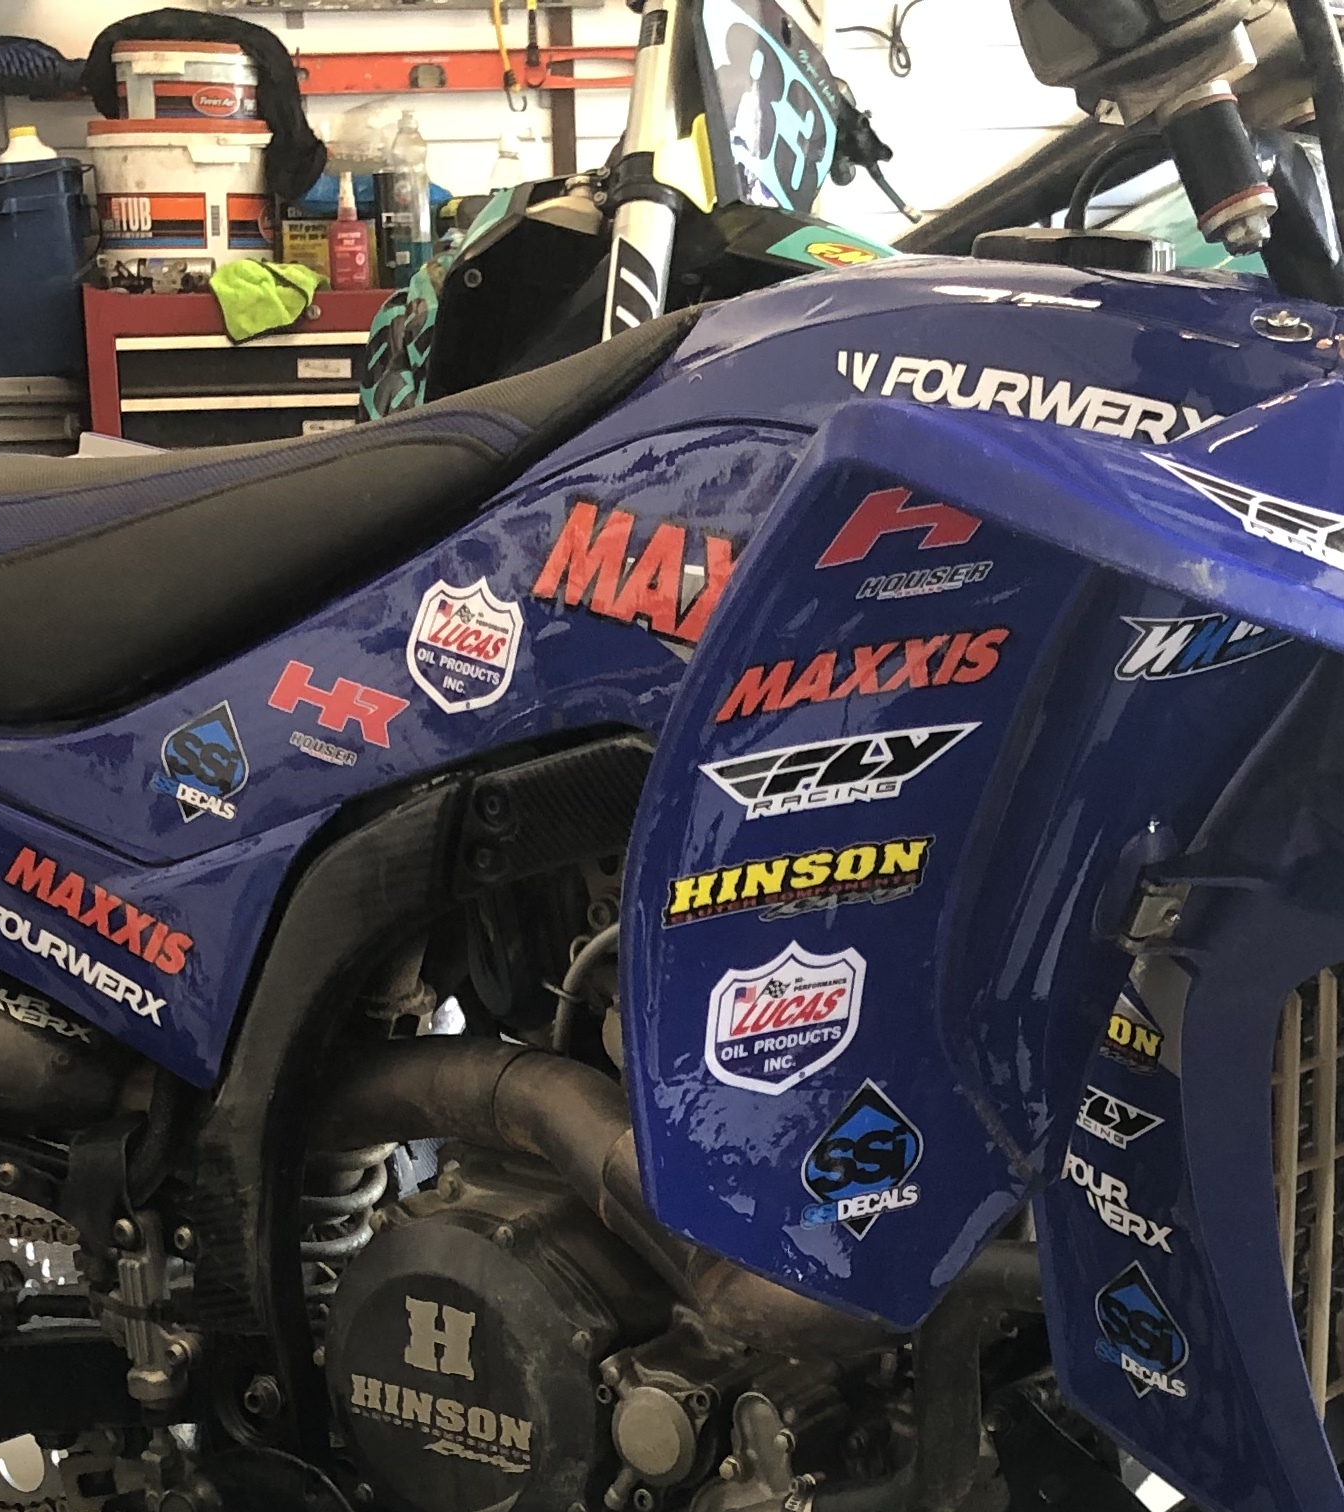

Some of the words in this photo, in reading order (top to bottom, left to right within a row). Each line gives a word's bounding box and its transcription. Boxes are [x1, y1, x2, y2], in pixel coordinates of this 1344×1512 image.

[120, 197, 152, 232] TUB
[880, 356, 1224, 445] FOURWERX
[532, 502, 737, 642] MAX
[858, 561, 993, 598] HOUSER
[428, 620, 507, 660] LUCAS
[416, 647, 436, 665] OIL
[439, 654, 500, 686] PRODUCTS
[442, 674, 467, 694] INC.
[716, 628, 1010, 723] MAXXIS
[290, 731, 357, 766] HOUSER
[761, 728, 966, 797] FLY
[752, 780, 899, 813] RACING
[670, 840, 928, 915] HINSON
[4, 847, 194, 975] MAXXIS
[793, 977, 847, 992] PERFORMANCE
[731, 987, 847, 1037] LUCAS
[720, 1043, 749, 1062] OIL
[754, 1025, 842, 1055] PRODUCTS
[763, 1054, 797, 1073] INC.
[1060, 1153, 1130, 1211] FOUR
[1086, 1190, 1174, 1254] WERX
[404, 1295, 476, 1381] H
[351, 1374, 533, 1451] HINSON
